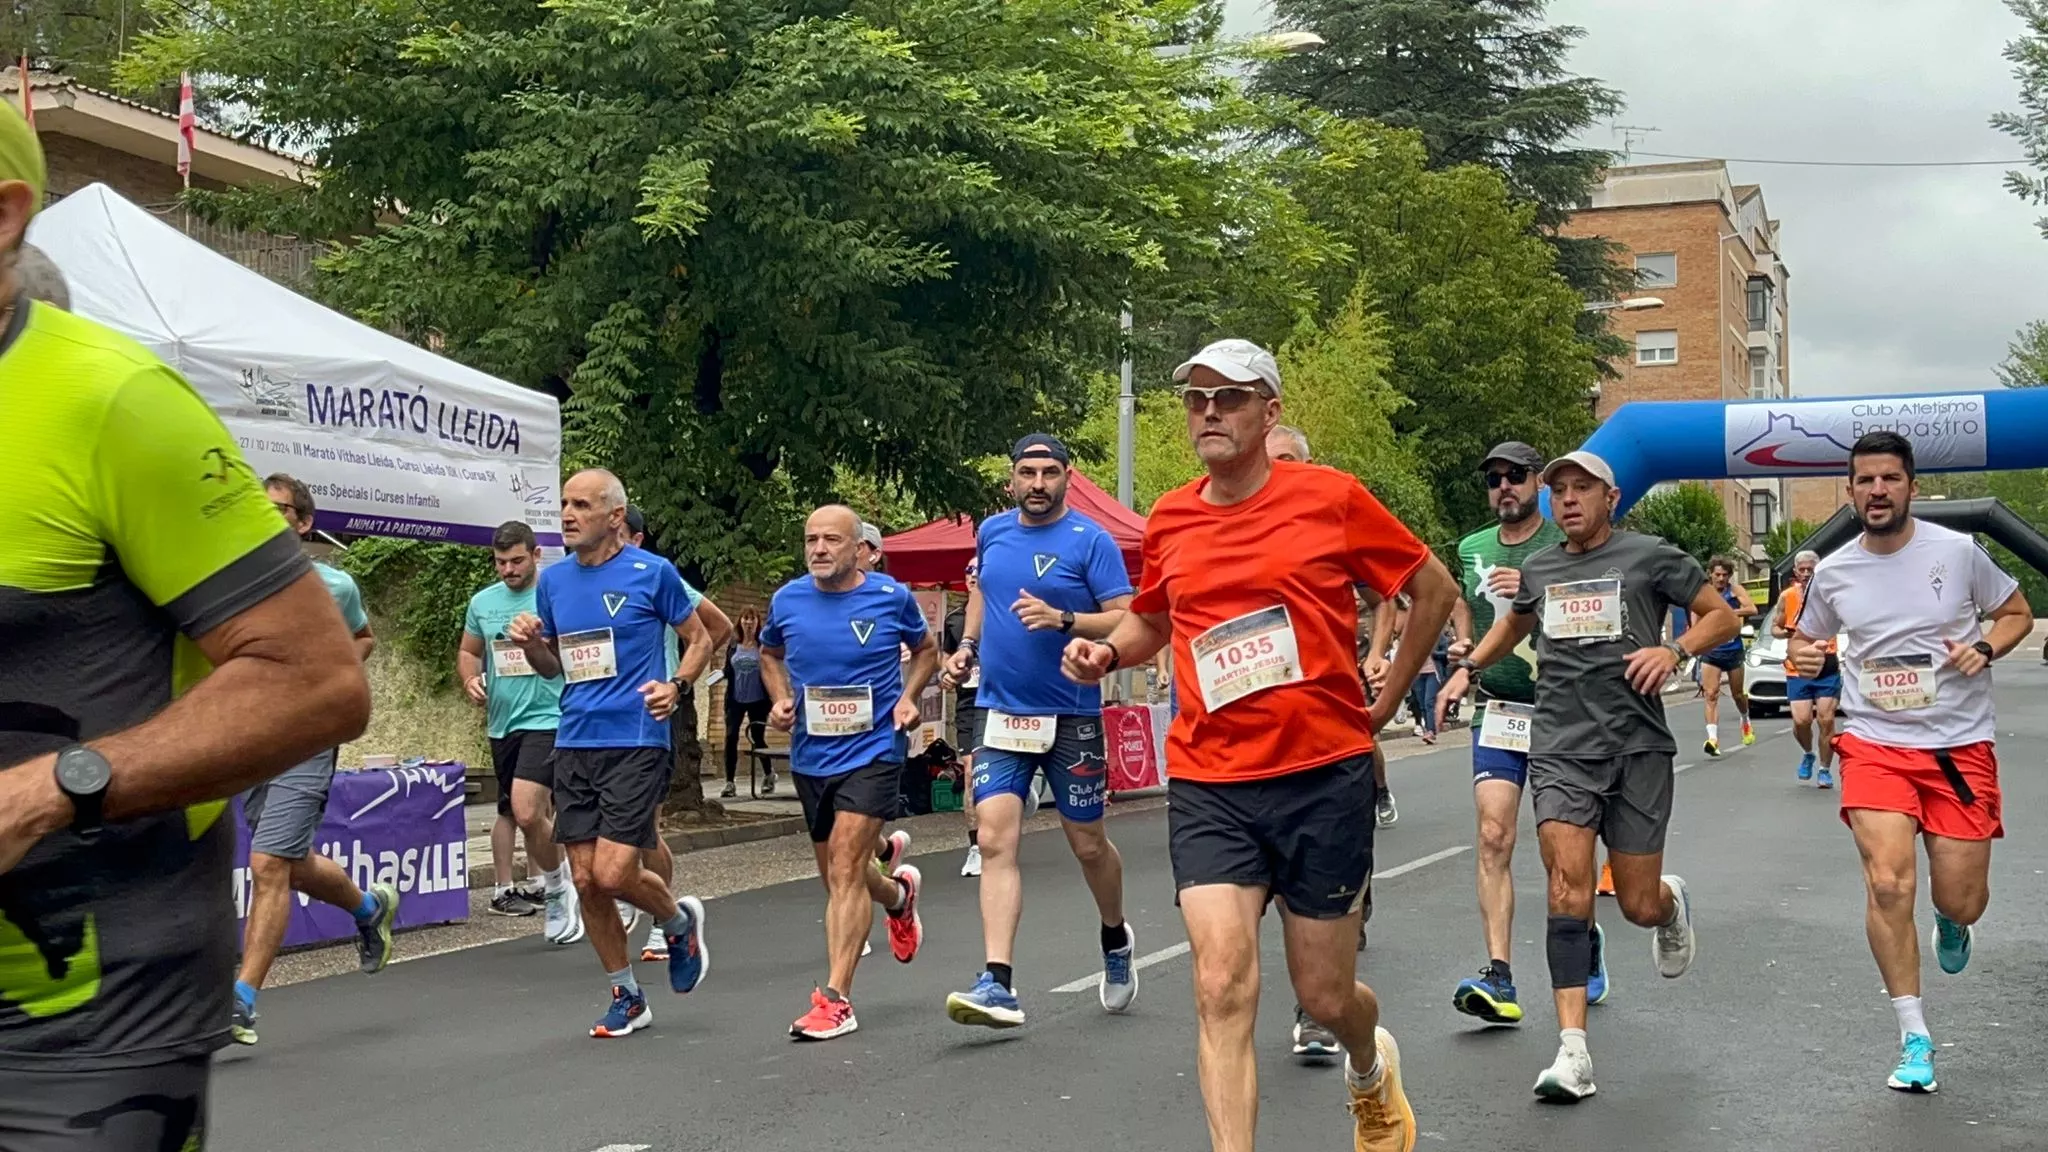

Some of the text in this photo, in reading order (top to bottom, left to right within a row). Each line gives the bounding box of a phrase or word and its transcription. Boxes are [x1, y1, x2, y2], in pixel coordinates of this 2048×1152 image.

[1852, 400, 1978, 417] Club Atletismo
[306, 383, 520, 454] MARATÓ LLEIDA
[240, 436, 249, 448] 27
[271, 441, 290, 454] 2024
[303, 443, 335, 461] Marató
[337, 447, 366, 465] Vithas
[396, 457, 420, 473] Cursa
[420, 462, 445, 477] Lleida
[462, 468, 487, 481] Cursa
[374, 488, 405, 505] Curses
[383, 521, 391, 532] A
[391, 522, 450, 537] PARTICIPAR!!
[1560, 598, 1603, 615] 1030
[570, 646, 600, 662] 1013
[1214, 635, 1274, 670] 1035
[1213, 655, 1286, 686] MARTIN JESUS
[1873, 671, 1919, 688] 1020
[819, 702, 858, 715] 1009
[1003, 716, 1041, 731] 1039
[1507, 718, 1526, 731] 58
[1069, 784, 1092, 794] Club
